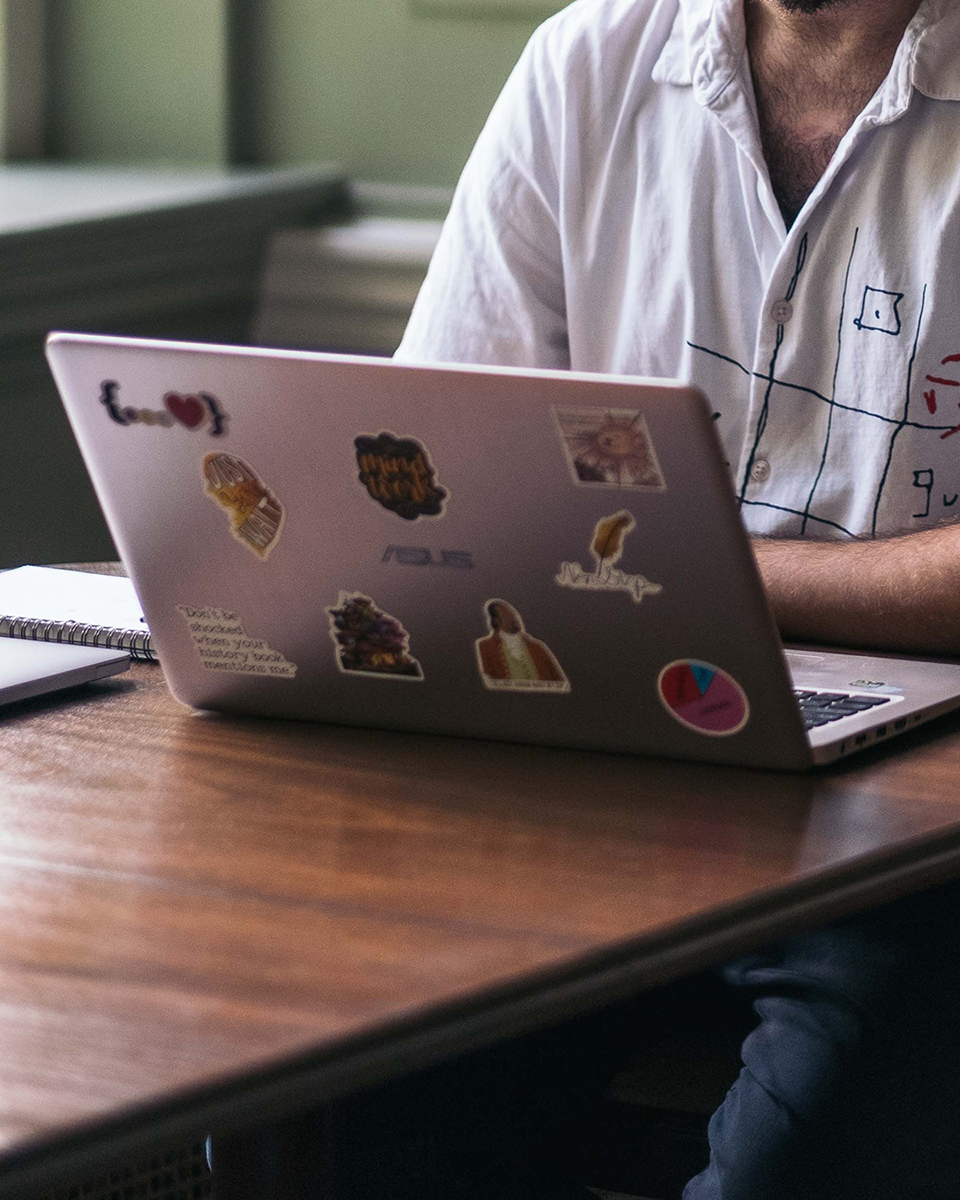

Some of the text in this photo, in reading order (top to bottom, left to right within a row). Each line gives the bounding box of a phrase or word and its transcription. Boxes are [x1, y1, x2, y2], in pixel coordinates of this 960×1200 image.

[190, 622, 243, 635] shocked
[193, 635, 264, 650] when your
[199, 648, 283, 662] history book
[204, 661, 267, 673] mentions
